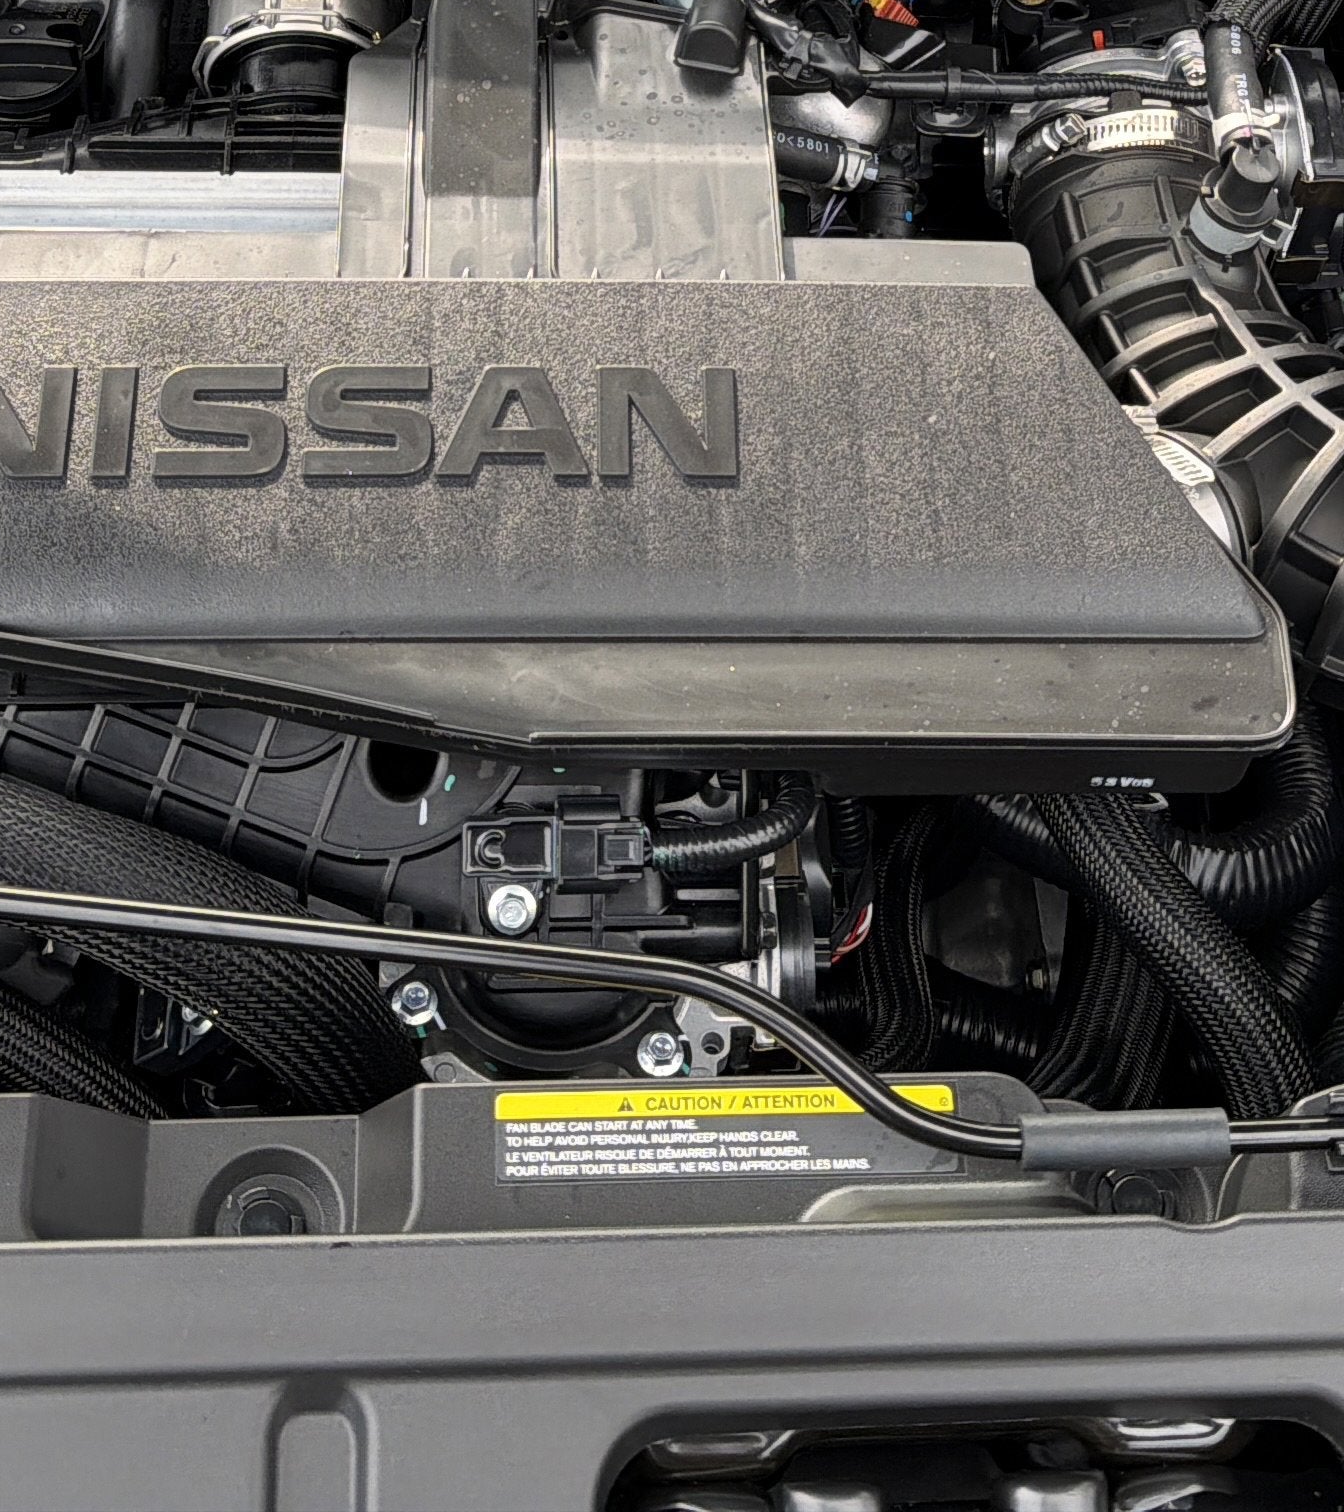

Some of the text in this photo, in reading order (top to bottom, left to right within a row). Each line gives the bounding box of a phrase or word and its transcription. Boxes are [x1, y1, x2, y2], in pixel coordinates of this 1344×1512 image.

[1230, 24, 1242, 55] 5806
[645, 1093, 836, 1112] CAUTION / ATTENTION
[506, 1118, 698, 1133] FAN BLADE CAN START AT ANY TIME.
[506, 1136, 522, 1147] TO
[524, 1135, 553, 1147] HELP
[554, 1135, 588, 1146] AVOID
[590, 1133, 649, 1145] PERSONAL
[719, 1130, 758, 1142] HANDS
[760, 1130, 799, 1141] CLEAR.
[506, 1151, 521, 1163] LE
[521, 1150, 594, 1162] VENTILATEUR
[638, 1148, 655, 1160] DE
[656, 1146, 717, 1160] DÉMARRER
[718, 1144, 728, 1158] À
[729, 1146, 757, 1157] TOUT
[759, 1145, 811, 1156] MOMENT.
[506, 1158, 871, 1177] POUR ÉVITER TOUTE BLESSURE, NE PAS EN APPROCHER LES MAINS.
